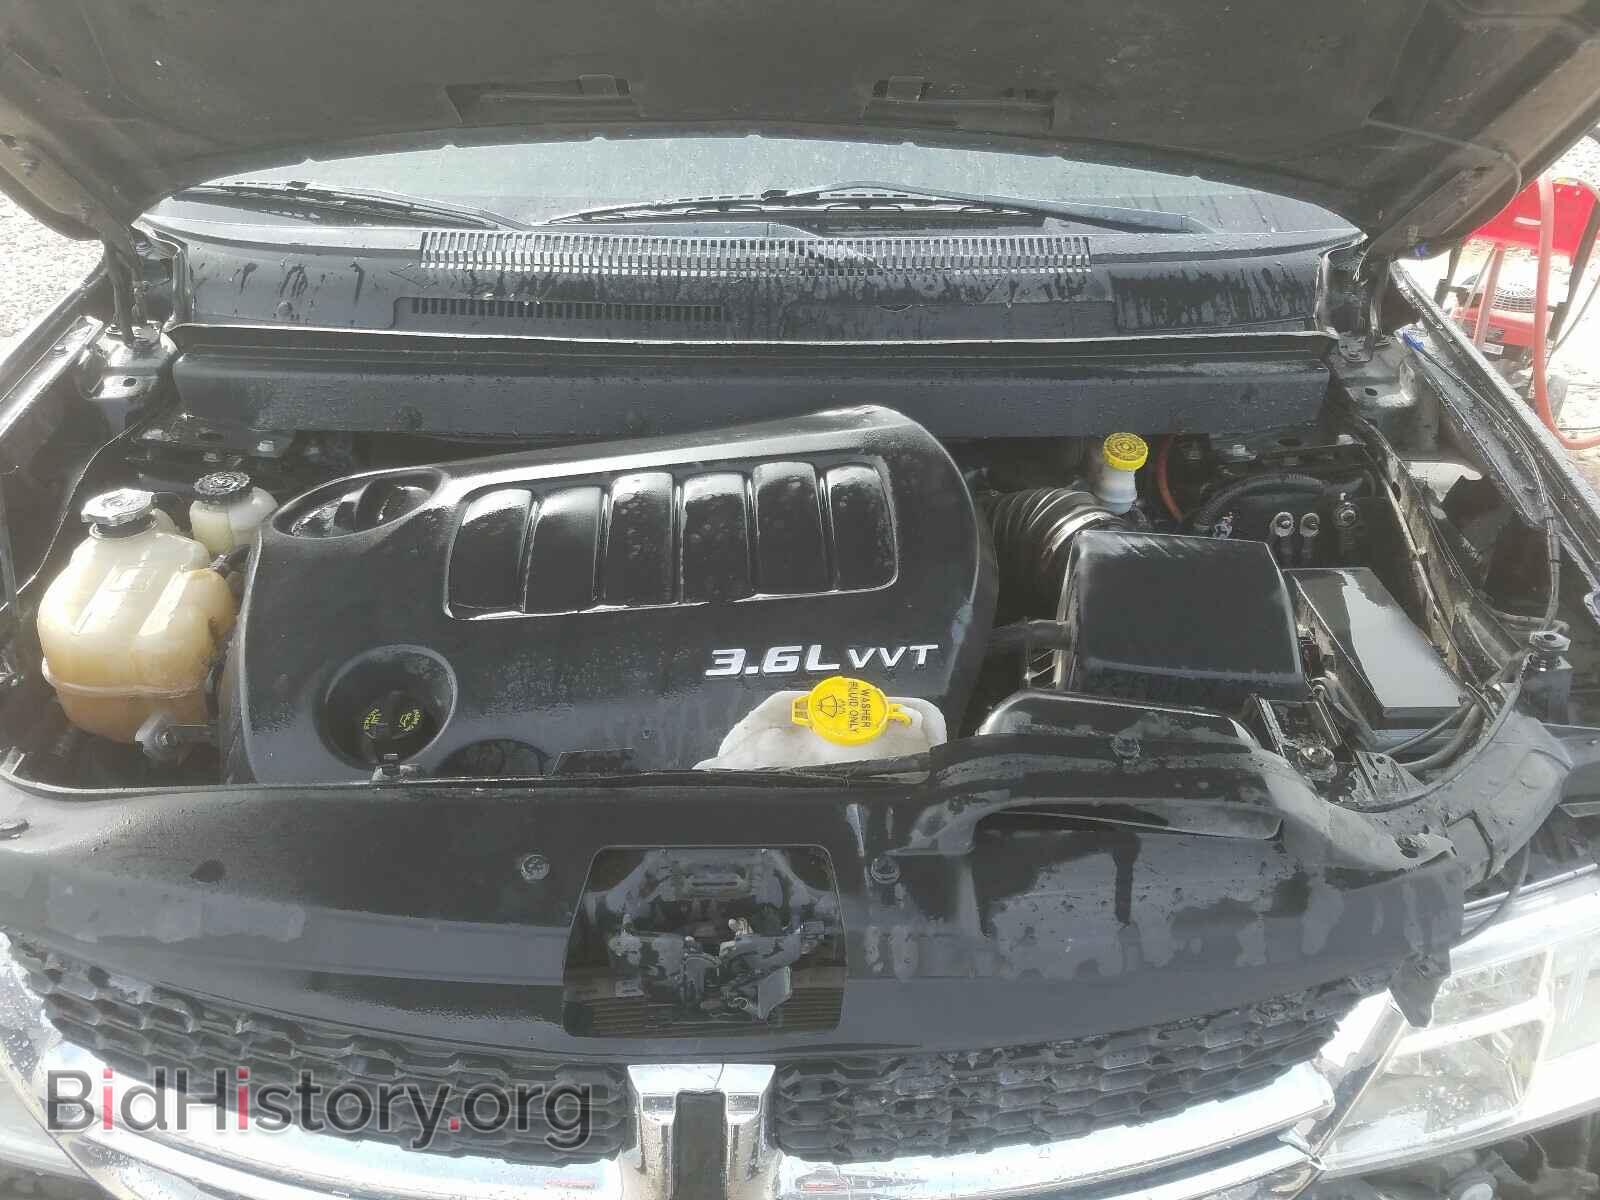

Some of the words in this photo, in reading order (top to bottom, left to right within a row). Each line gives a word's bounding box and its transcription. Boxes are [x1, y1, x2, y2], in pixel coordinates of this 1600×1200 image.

[705, 645, 841, 677] 3.6L
[848, 644, 939, 669] VVT
[848, 681, 859, 707] FLUID
[861, 688, 872, 728] WASHER
[848, 708, 860, 733] ONLY
